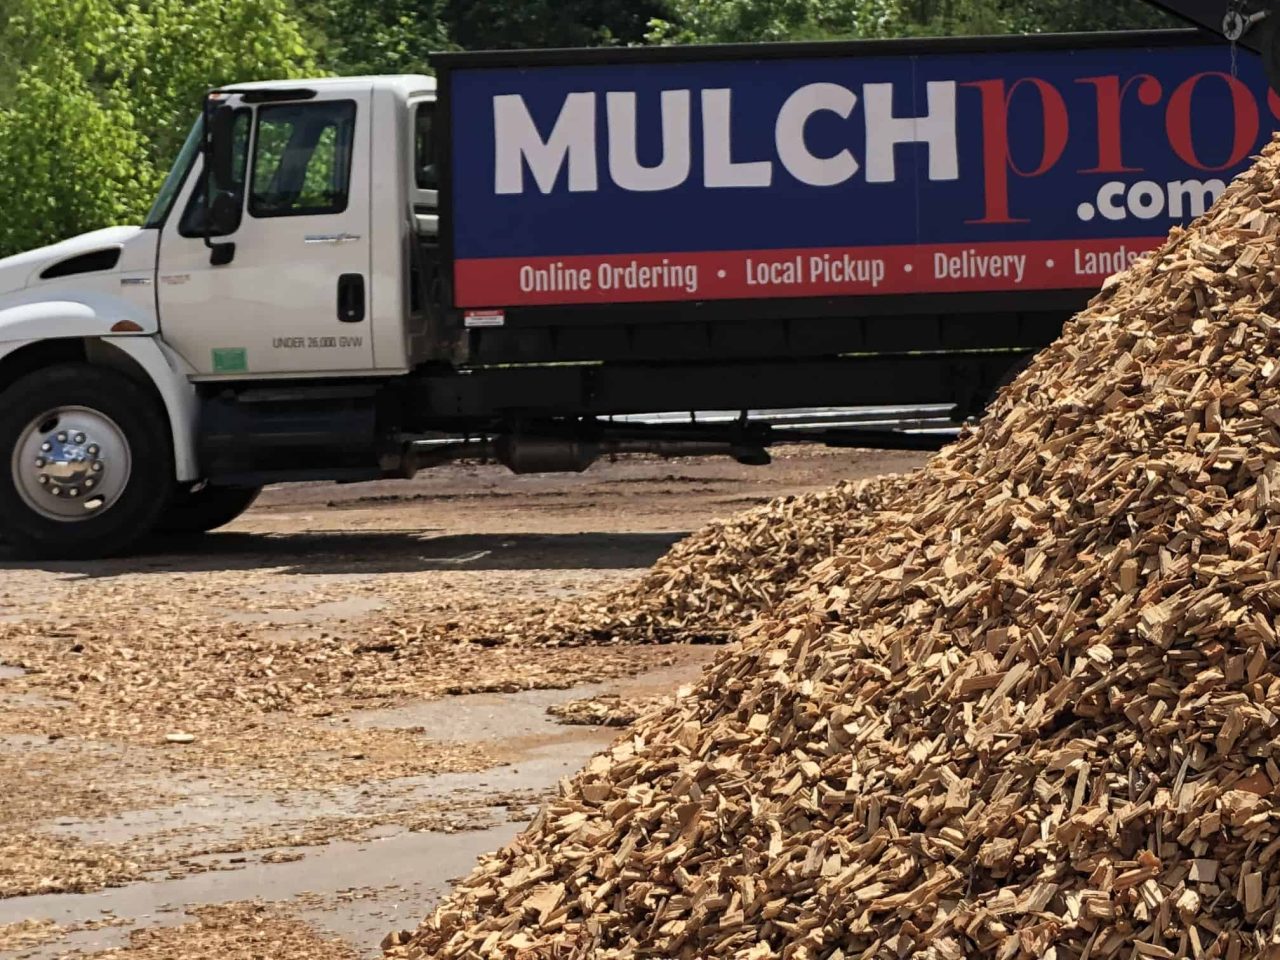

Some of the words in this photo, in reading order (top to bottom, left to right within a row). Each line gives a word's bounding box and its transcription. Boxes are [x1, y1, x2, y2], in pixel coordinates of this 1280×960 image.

[519, 262, 591, 292] Online
[598, 259, 698, 292] Ordering
[746, 256, 802, 285] Local
[810, 254, 885, 286] Pickup
[934, 249, 1026, 282] Delivery
